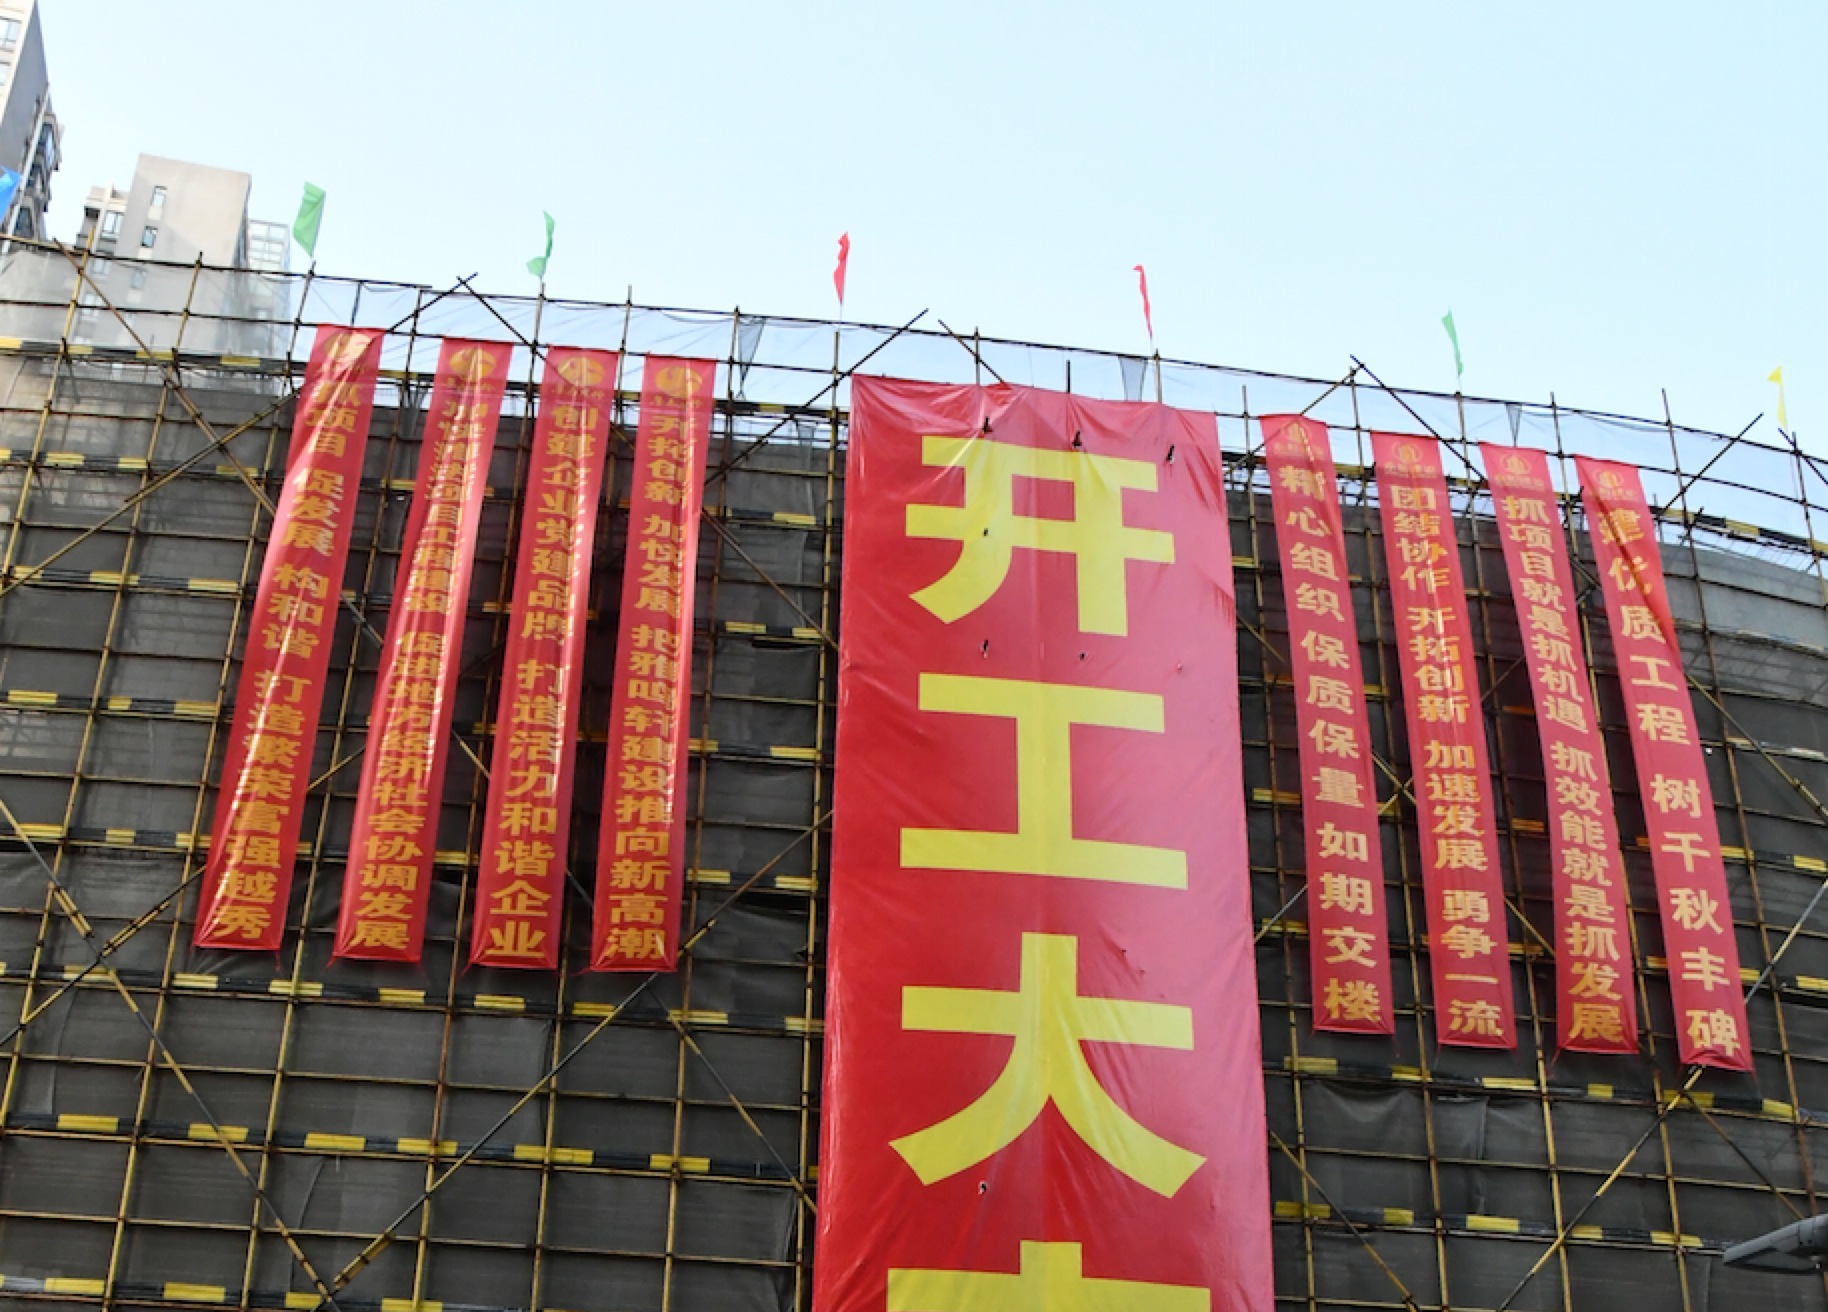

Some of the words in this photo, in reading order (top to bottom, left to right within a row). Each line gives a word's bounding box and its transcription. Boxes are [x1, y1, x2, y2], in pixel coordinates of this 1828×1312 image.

[280, 465, 345, 556] 促发展
[520, 404, 600, 646] 创建企业党建品牌
[643, 413, 697, 509] 开拓创新
[261, 562, 329, 658] 构和谐
[633, 513, 687, 619] 加快发展
[1390, 484, 1452, 594] 团结协作
[1405, 606, 1470, 724] 开拓创新
[213, 668, 312, 940] 打造繁荣富强越秀
[350, 631, 447, 949] 促进地方经济社会协调发展
[485, 659, 571, 958] 打造活力和谐企业
[605, 623, 682, 960] 把雅鸣轩建设推向新高潮
[1423, 739, 1489, 871] 加速发展
[1501, 495, 1589, 735] 抓项目就是抓机遇
[1550, 740, 1623, 1042] 抓效能就是抓发展
[1597, 507, 1692, 746] 建优质工程
[1649, 773, 1741, 1057] 树千秋丰碑
[1440, 889, 1505, 1037] 勇争一流
